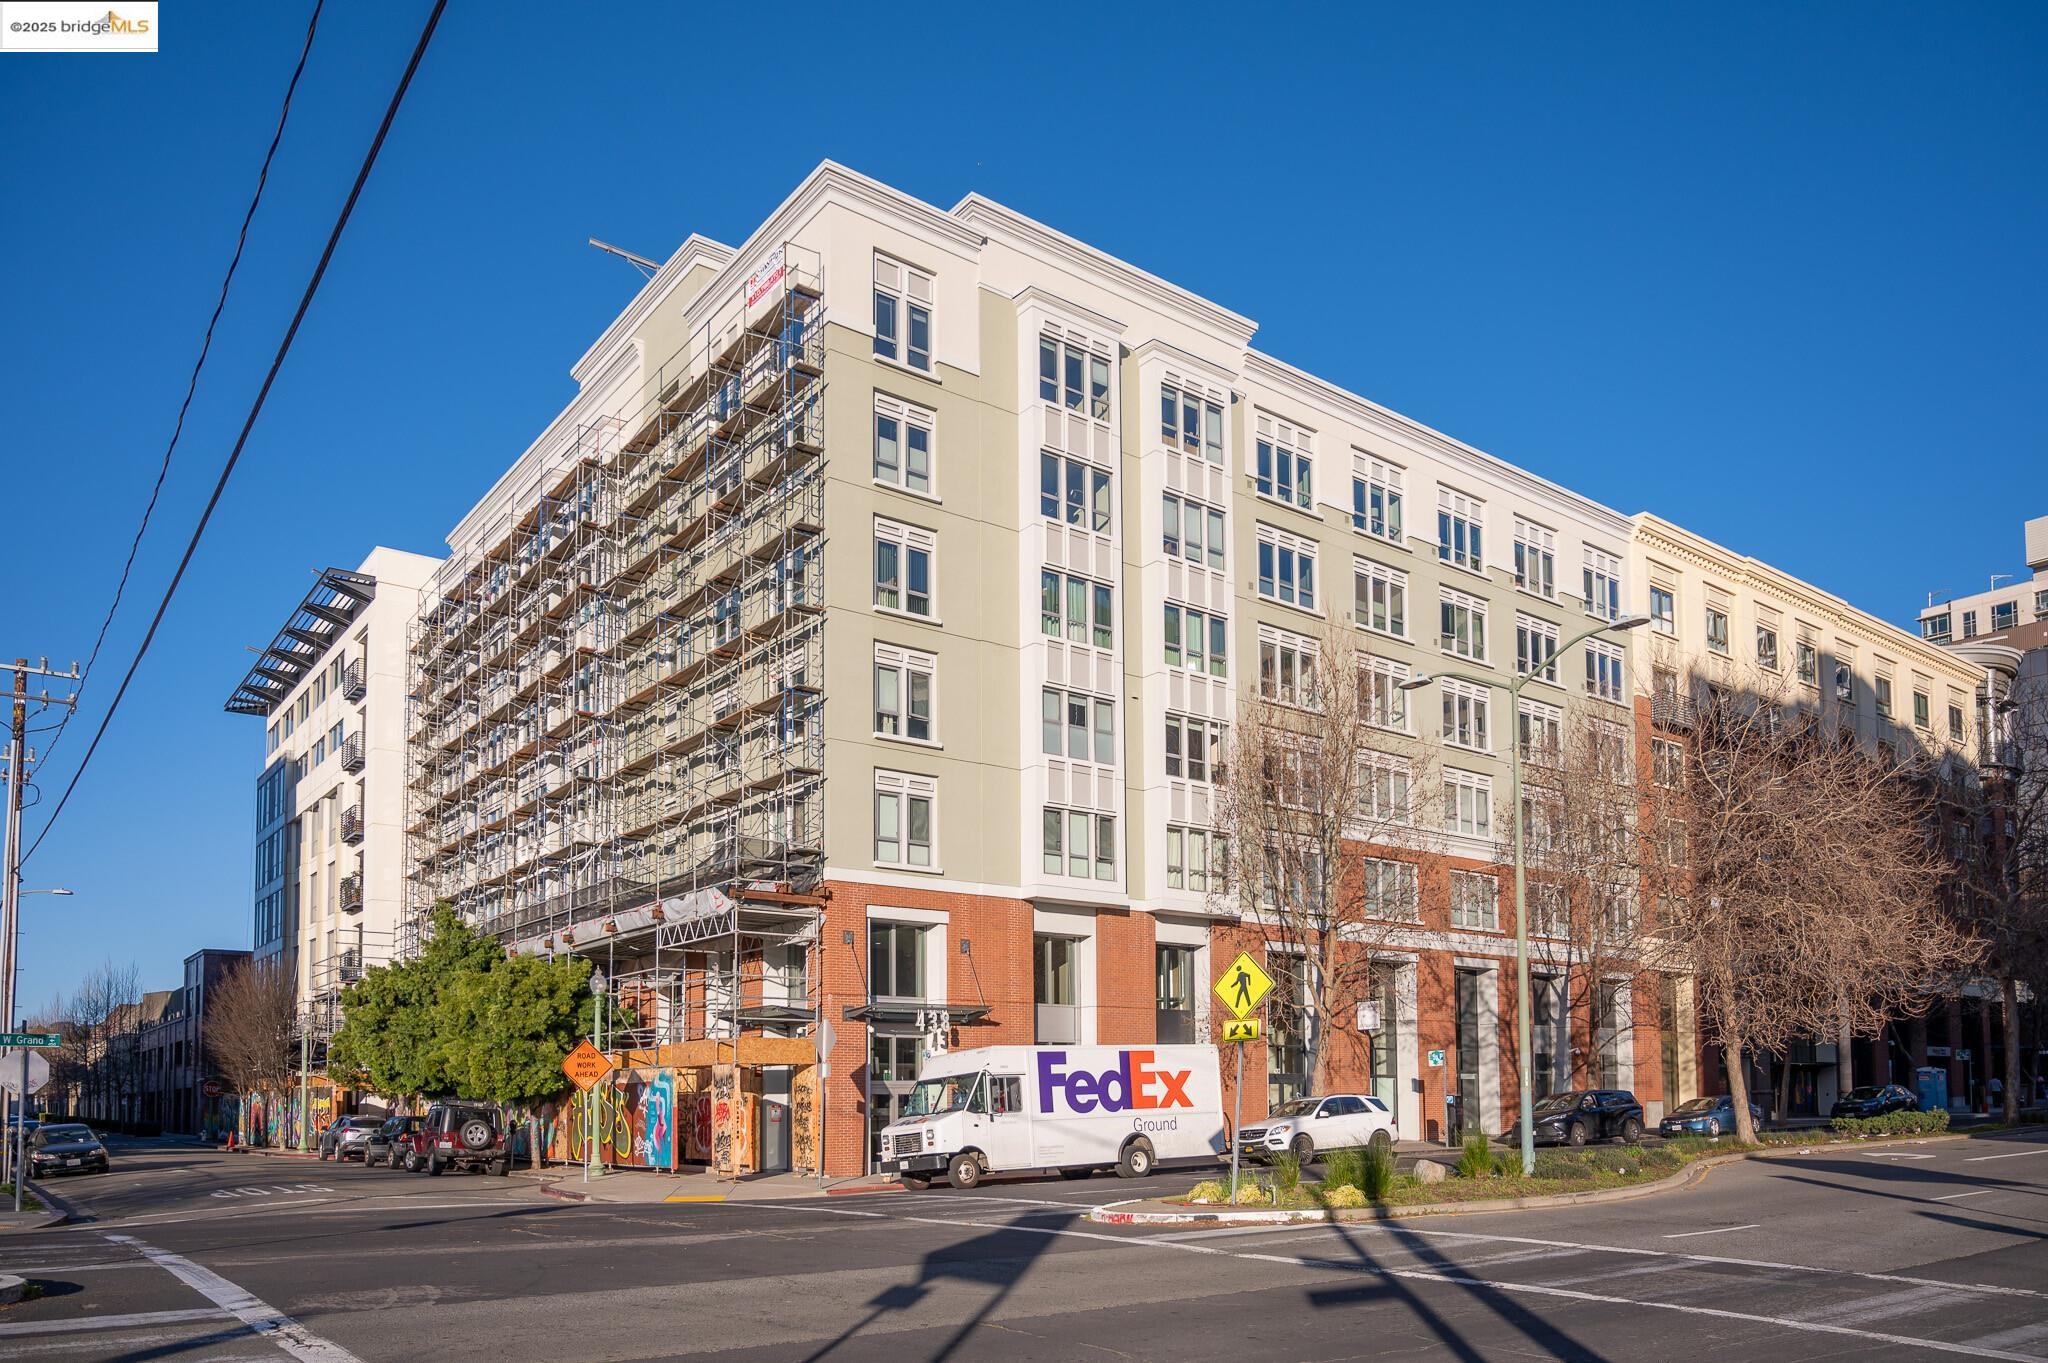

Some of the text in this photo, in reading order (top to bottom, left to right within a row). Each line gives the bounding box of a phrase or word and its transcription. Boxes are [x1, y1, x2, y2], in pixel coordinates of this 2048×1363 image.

[915, 1009, 950, 1031] 438
[3, 1036, 11, 1044] W
[16, 1036, 44, 1045] Grand
[1037, 1050, 1194, 1114] FedEx
[1133, 1117, 1177, 1132] Ground
